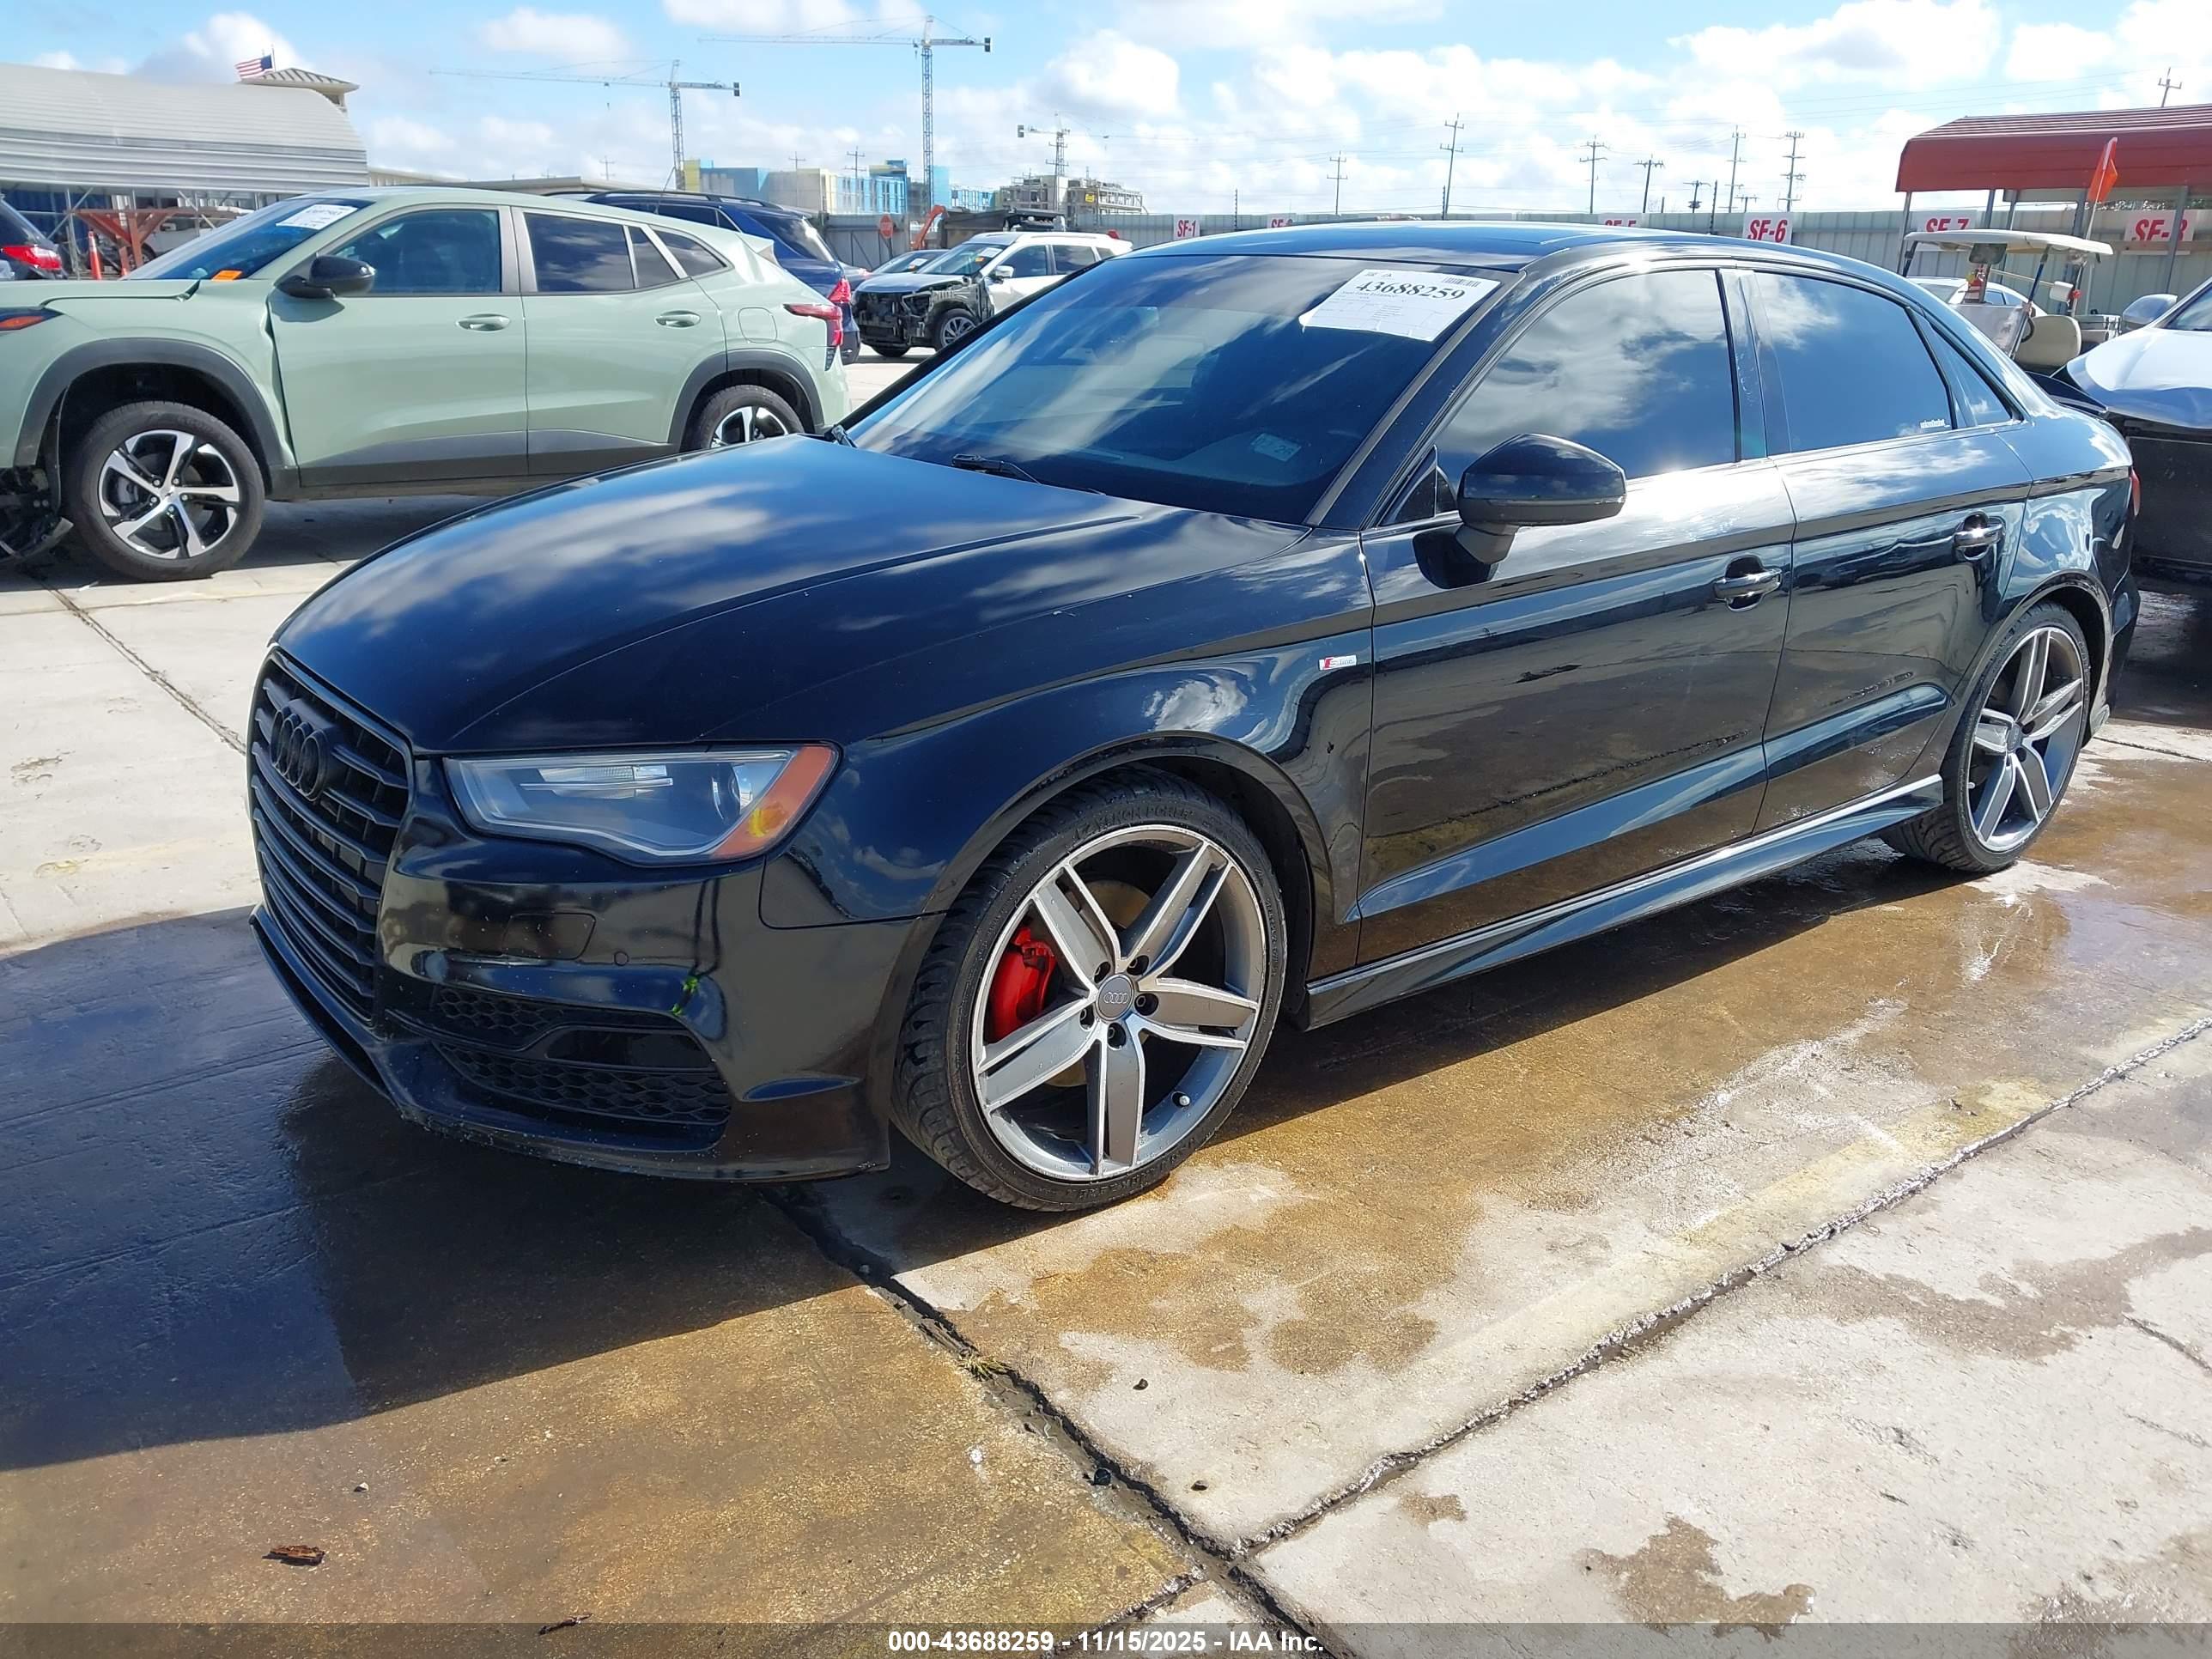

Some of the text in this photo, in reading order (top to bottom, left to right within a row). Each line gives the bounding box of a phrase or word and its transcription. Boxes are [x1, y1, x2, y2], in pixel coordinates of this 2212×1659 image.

[1177, 219, 1196, 237] SF-1
[1747, 219, 1787, 242] SF-6
[1355, 281, 1465, 301] 43688259
